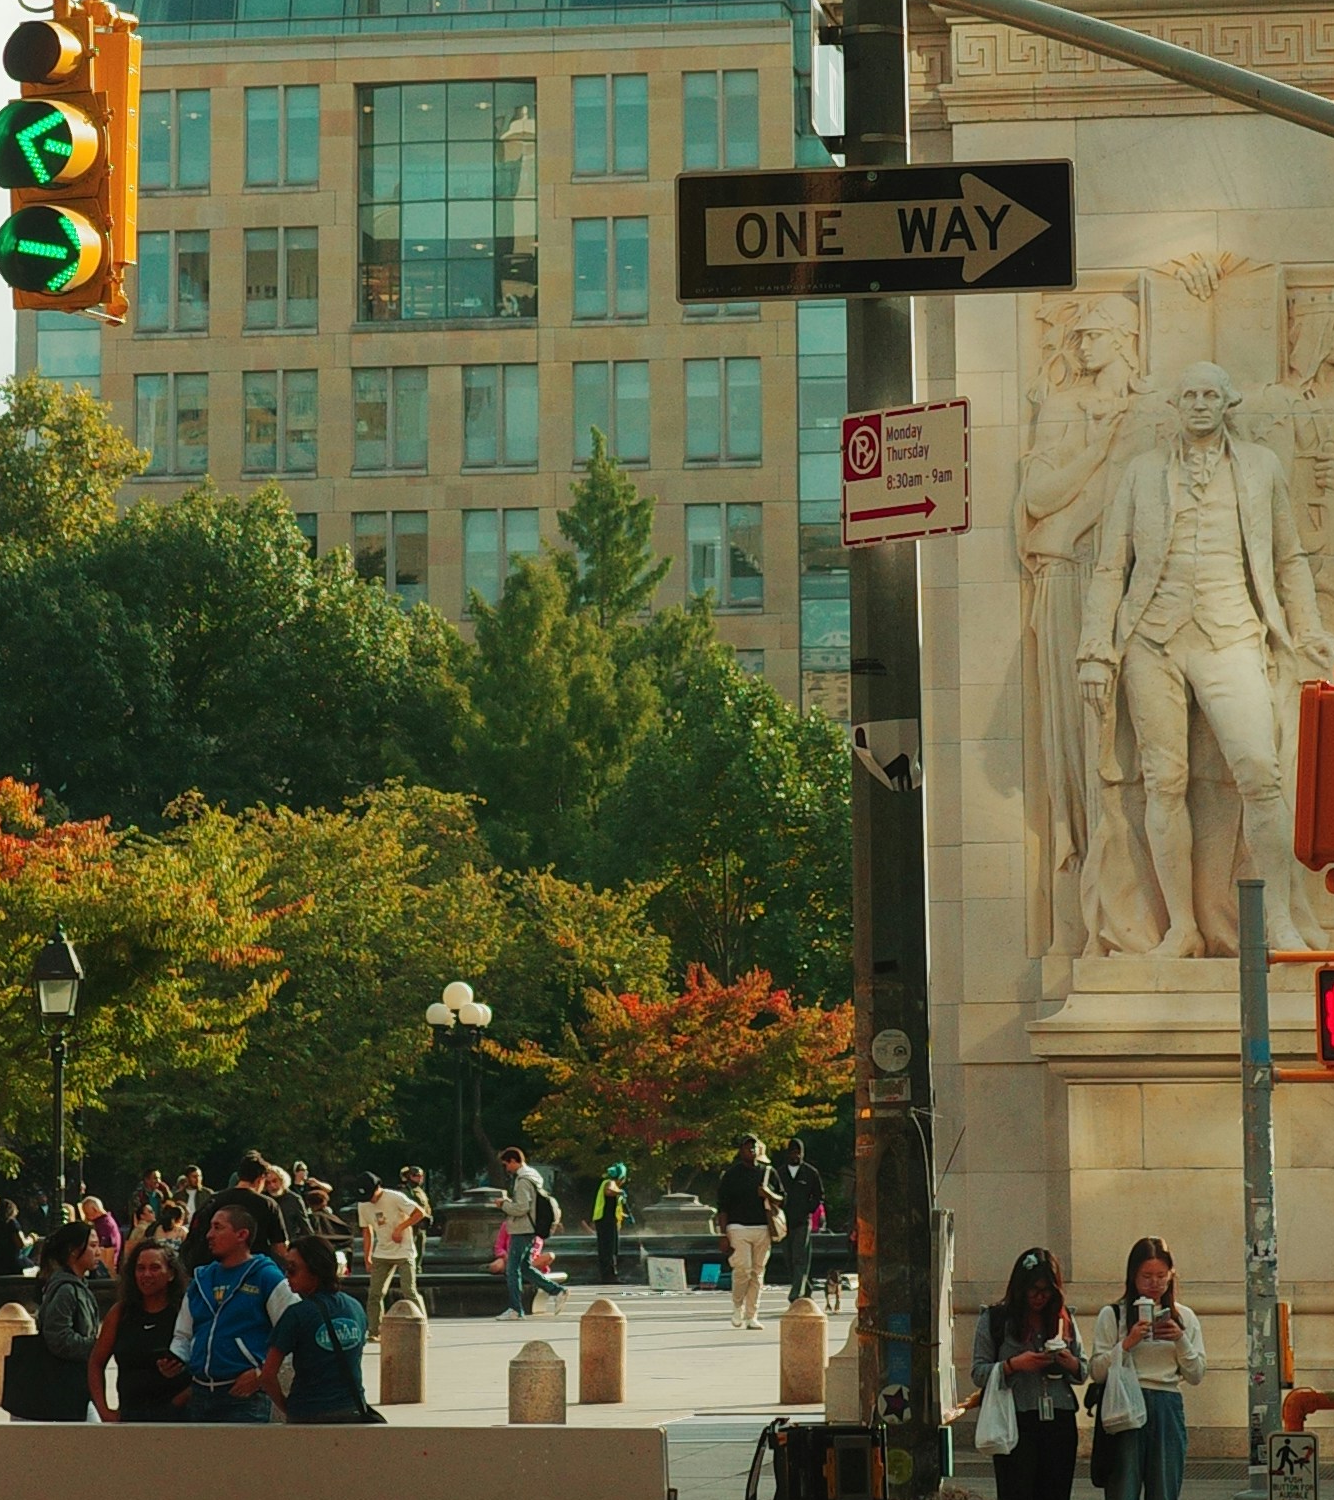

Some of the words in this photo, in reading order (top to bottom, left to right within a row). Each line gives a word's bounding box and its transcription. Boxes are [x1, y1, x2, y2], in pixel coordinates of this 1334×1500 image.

[735, 210, 844, 259] ONE
[897, 203, 1011, 254] WAY
[886, 423, 923, 442] Monday
[886, 443, 930, 462] Thursday
[886, 472, 923, 491] 8:30am
[931, 468, 953, 485] 9am
[1273, 1483, 1299, 1491] BUTTON
[1300, 1483, 1314, 1491] FOR
[1279, 1491, 1308, 1499] AUDIBLE
